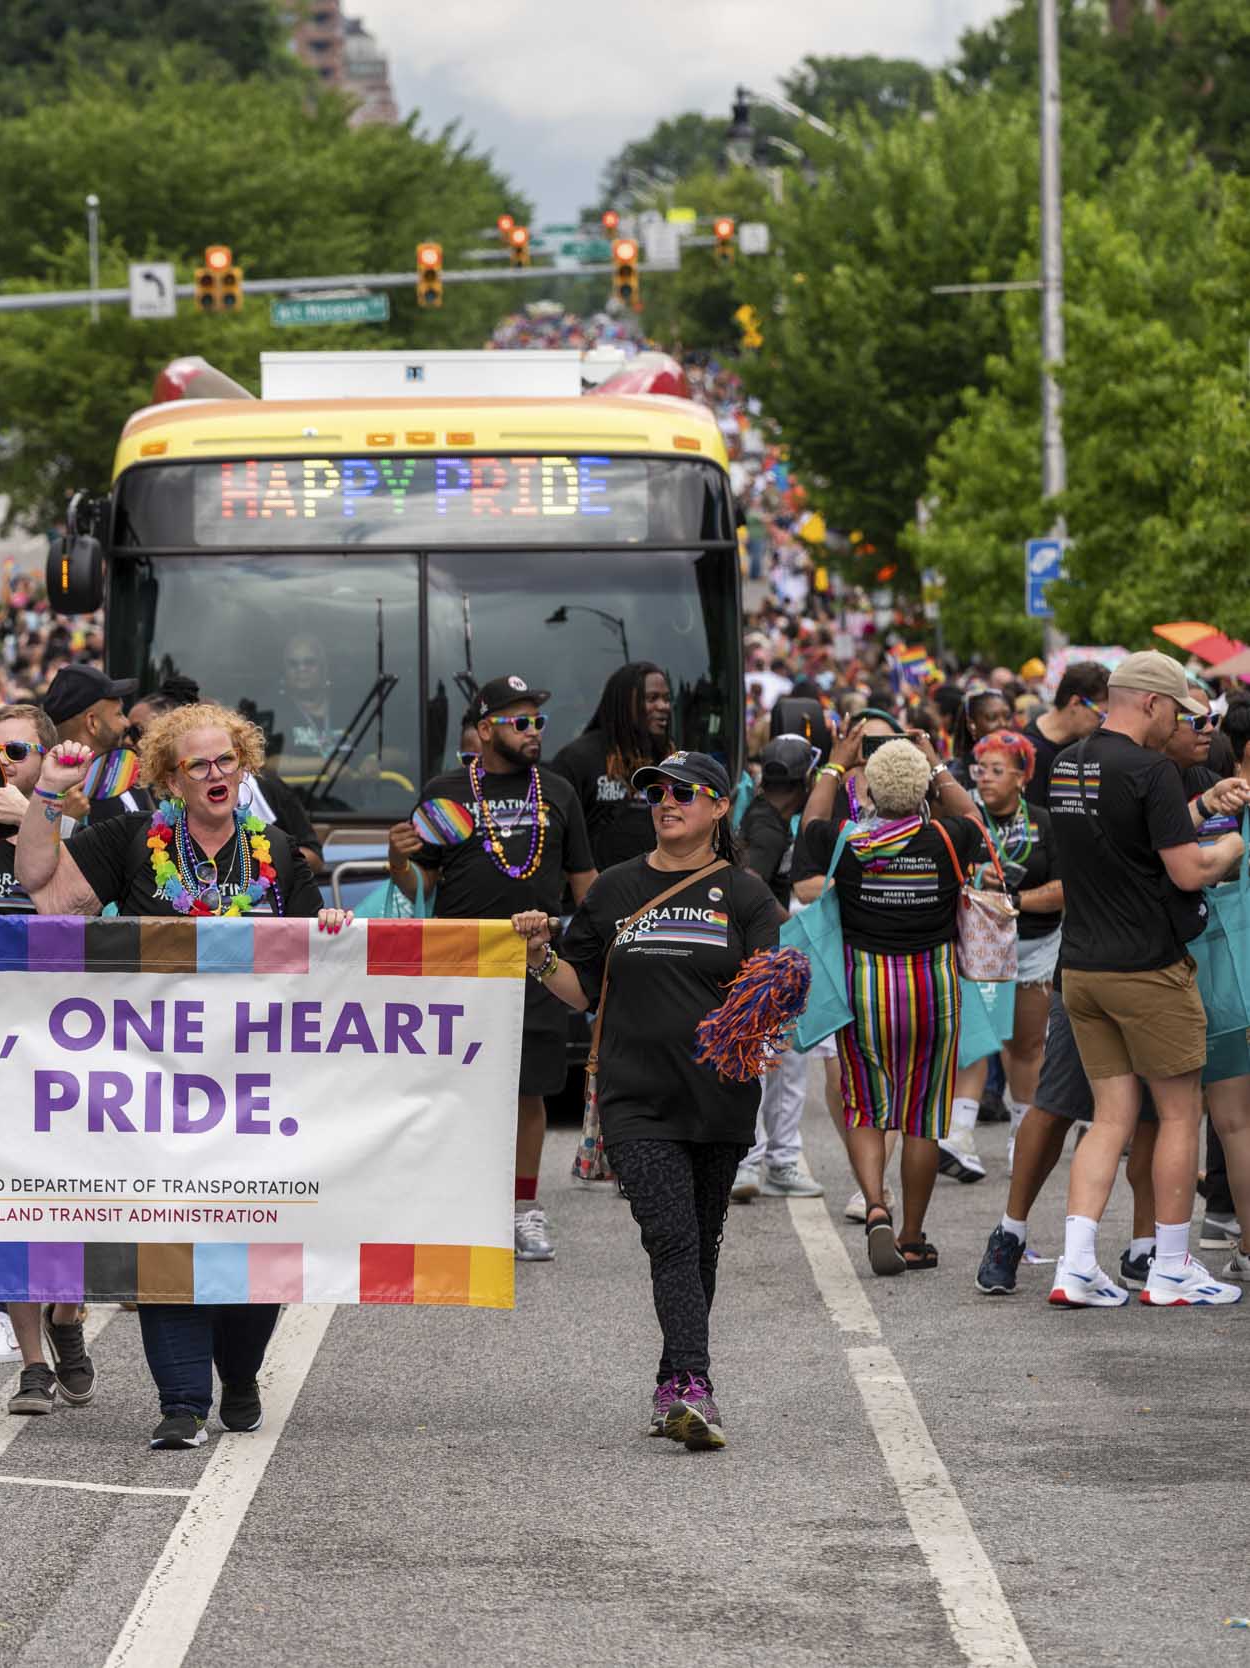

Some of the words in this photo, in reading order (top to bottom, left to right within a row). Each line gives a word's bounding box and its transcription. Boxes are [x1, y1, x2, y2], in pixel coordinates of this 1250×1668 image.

[221, 457, 417, 519] HAPPY
[435, 456, 612, 517] PRIDE
[48, 997, 204, 1053] ONE
[235, 1001, 482, 1064] HEART,
[34, 1070, 298, 1136] PRIDE.
[11, 1178, 127, 1193] DEPARTMENT
[133, 1179, 156, 1193] OF
[161, 1179, 319, 1195] TRANSPORTATION
[49, 1207, 123, 1222] TRANSIT
[128, 1208, 278, 1223] ADMINISTRATION
